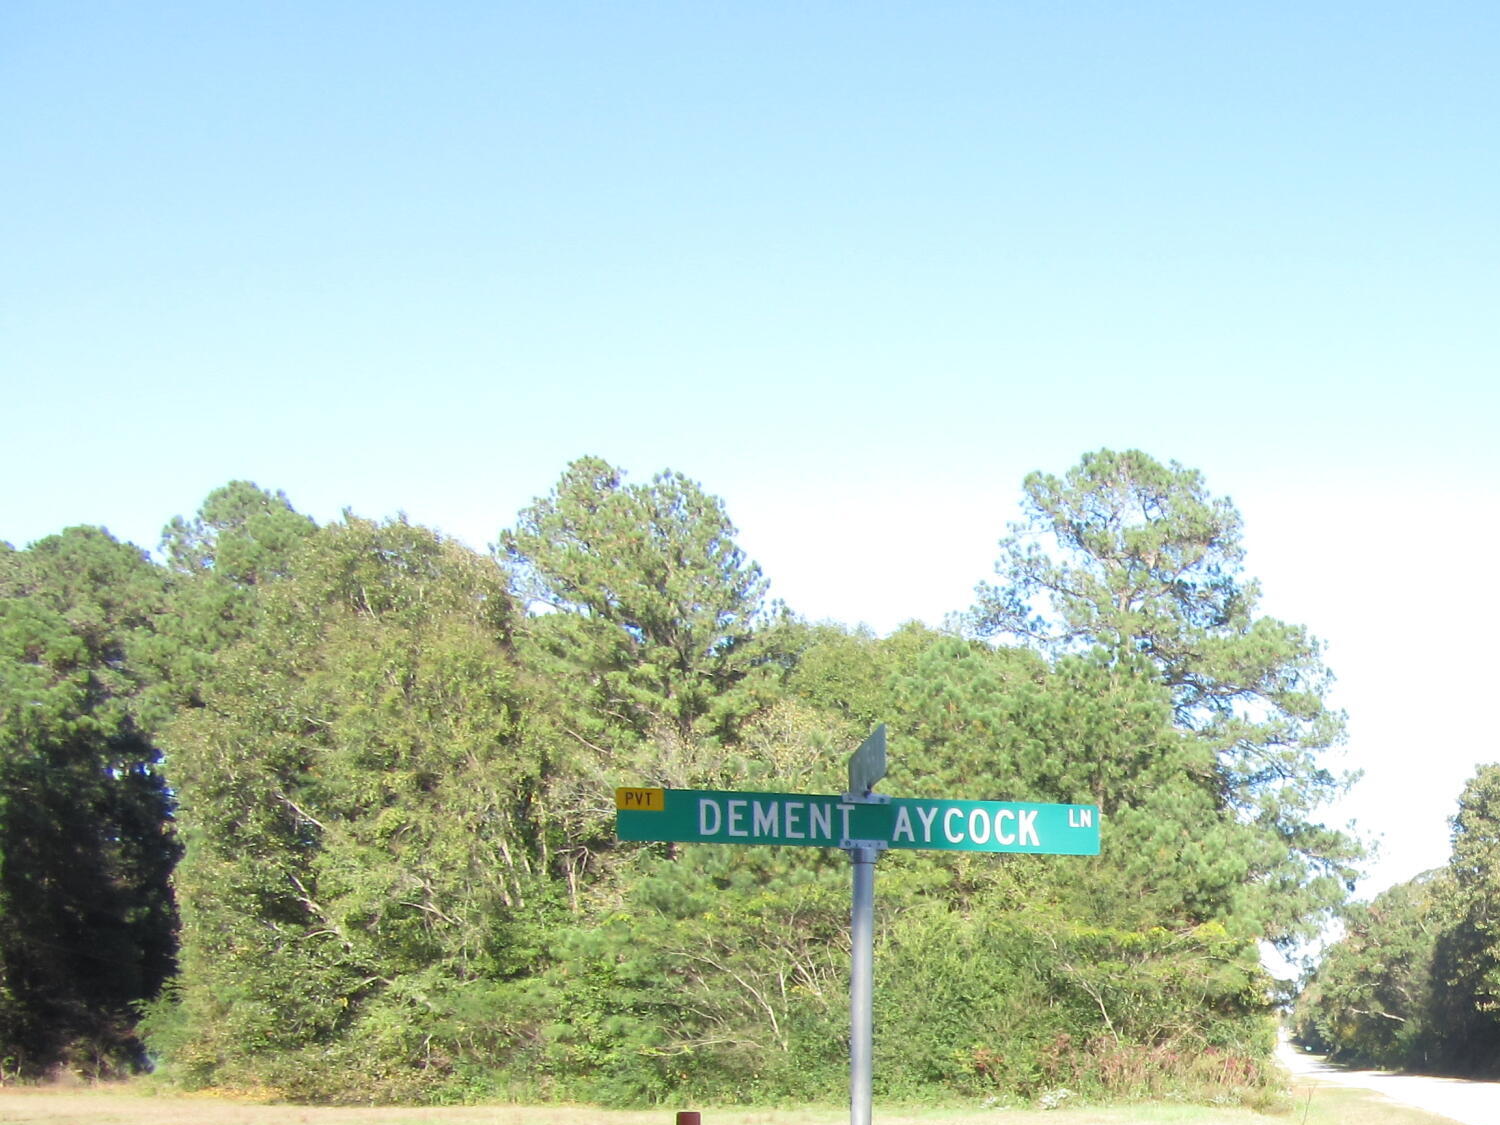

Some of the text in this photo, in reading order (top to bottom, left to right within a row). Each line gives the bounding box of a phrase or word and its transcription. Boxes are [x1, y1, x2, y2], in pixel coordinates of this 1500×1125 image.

[625, 792, 652, 806] PVT
[700, 798, 1092, 846] DEMENT AYCOCK LN
